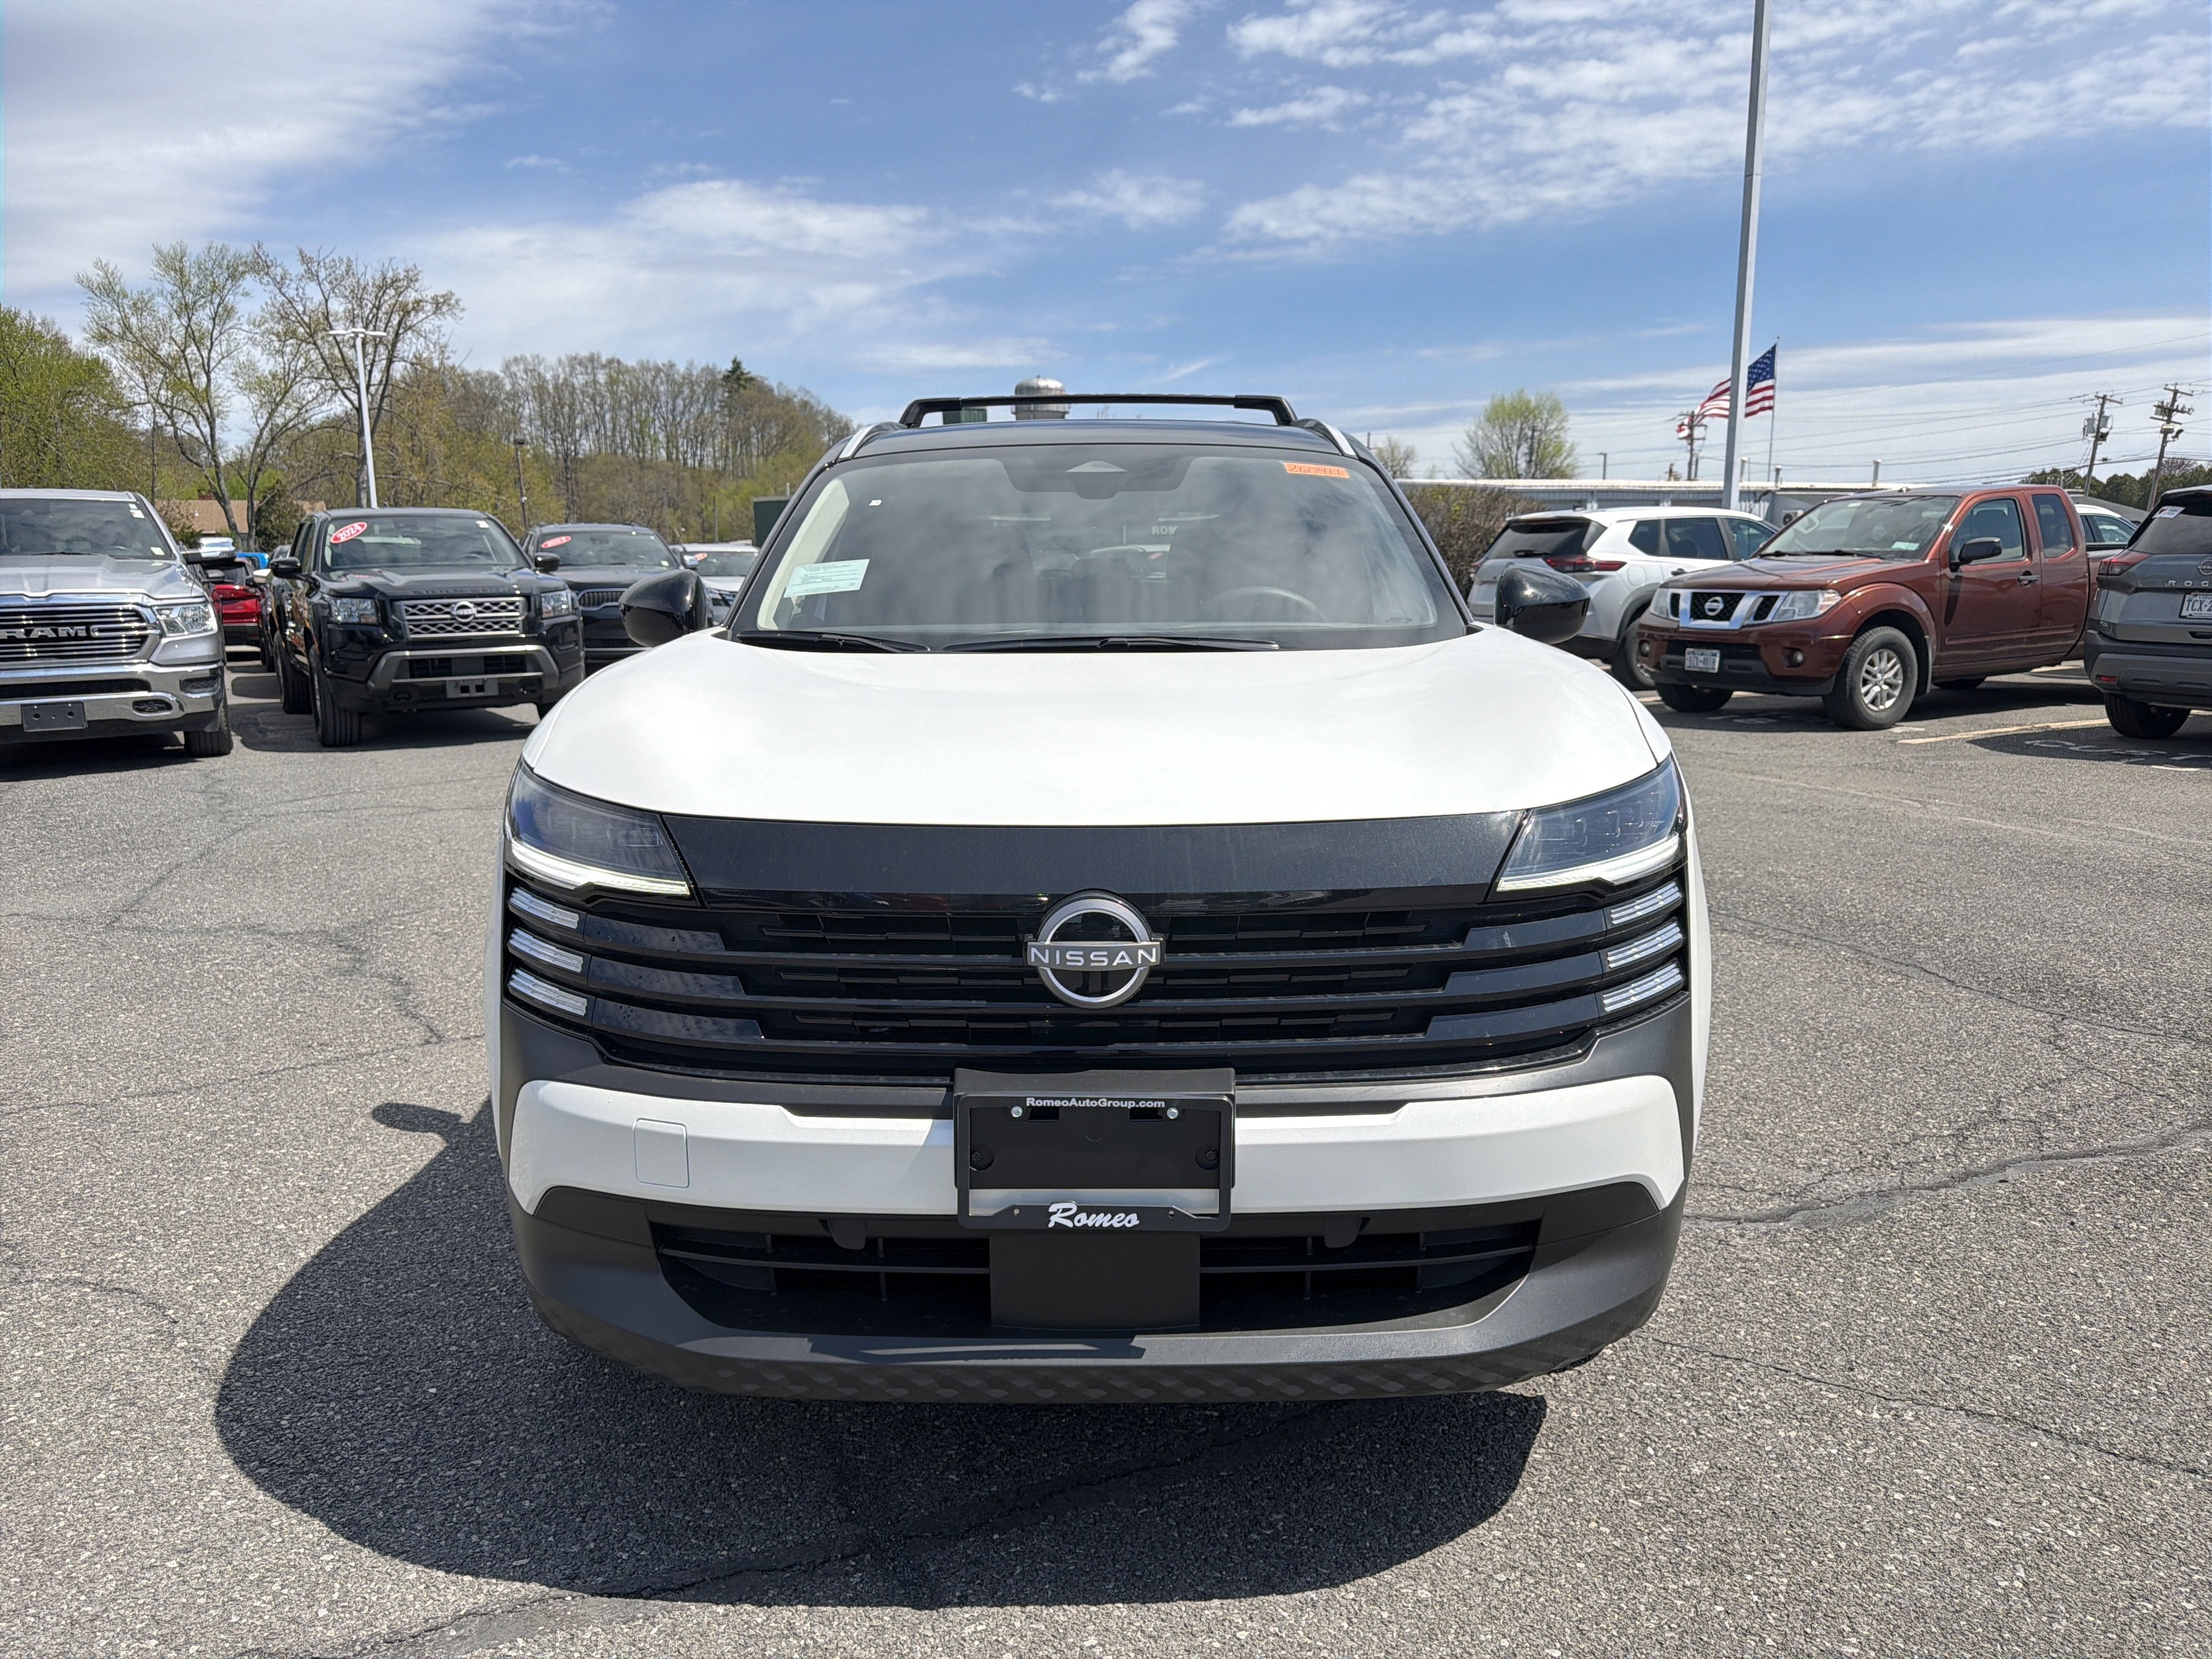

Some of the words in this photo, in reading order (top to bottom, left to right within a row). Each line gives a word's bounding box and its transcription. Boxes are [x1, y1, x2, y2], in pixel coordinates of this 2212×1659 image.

[0, 626, 87, 639] RAM
[1031, 947, 1156, 966] NISSAN
[1026, 1097, 1165, 1108] RomeoAutoGroup.com
[1048, 1203, 1140, 1228] Romeo
